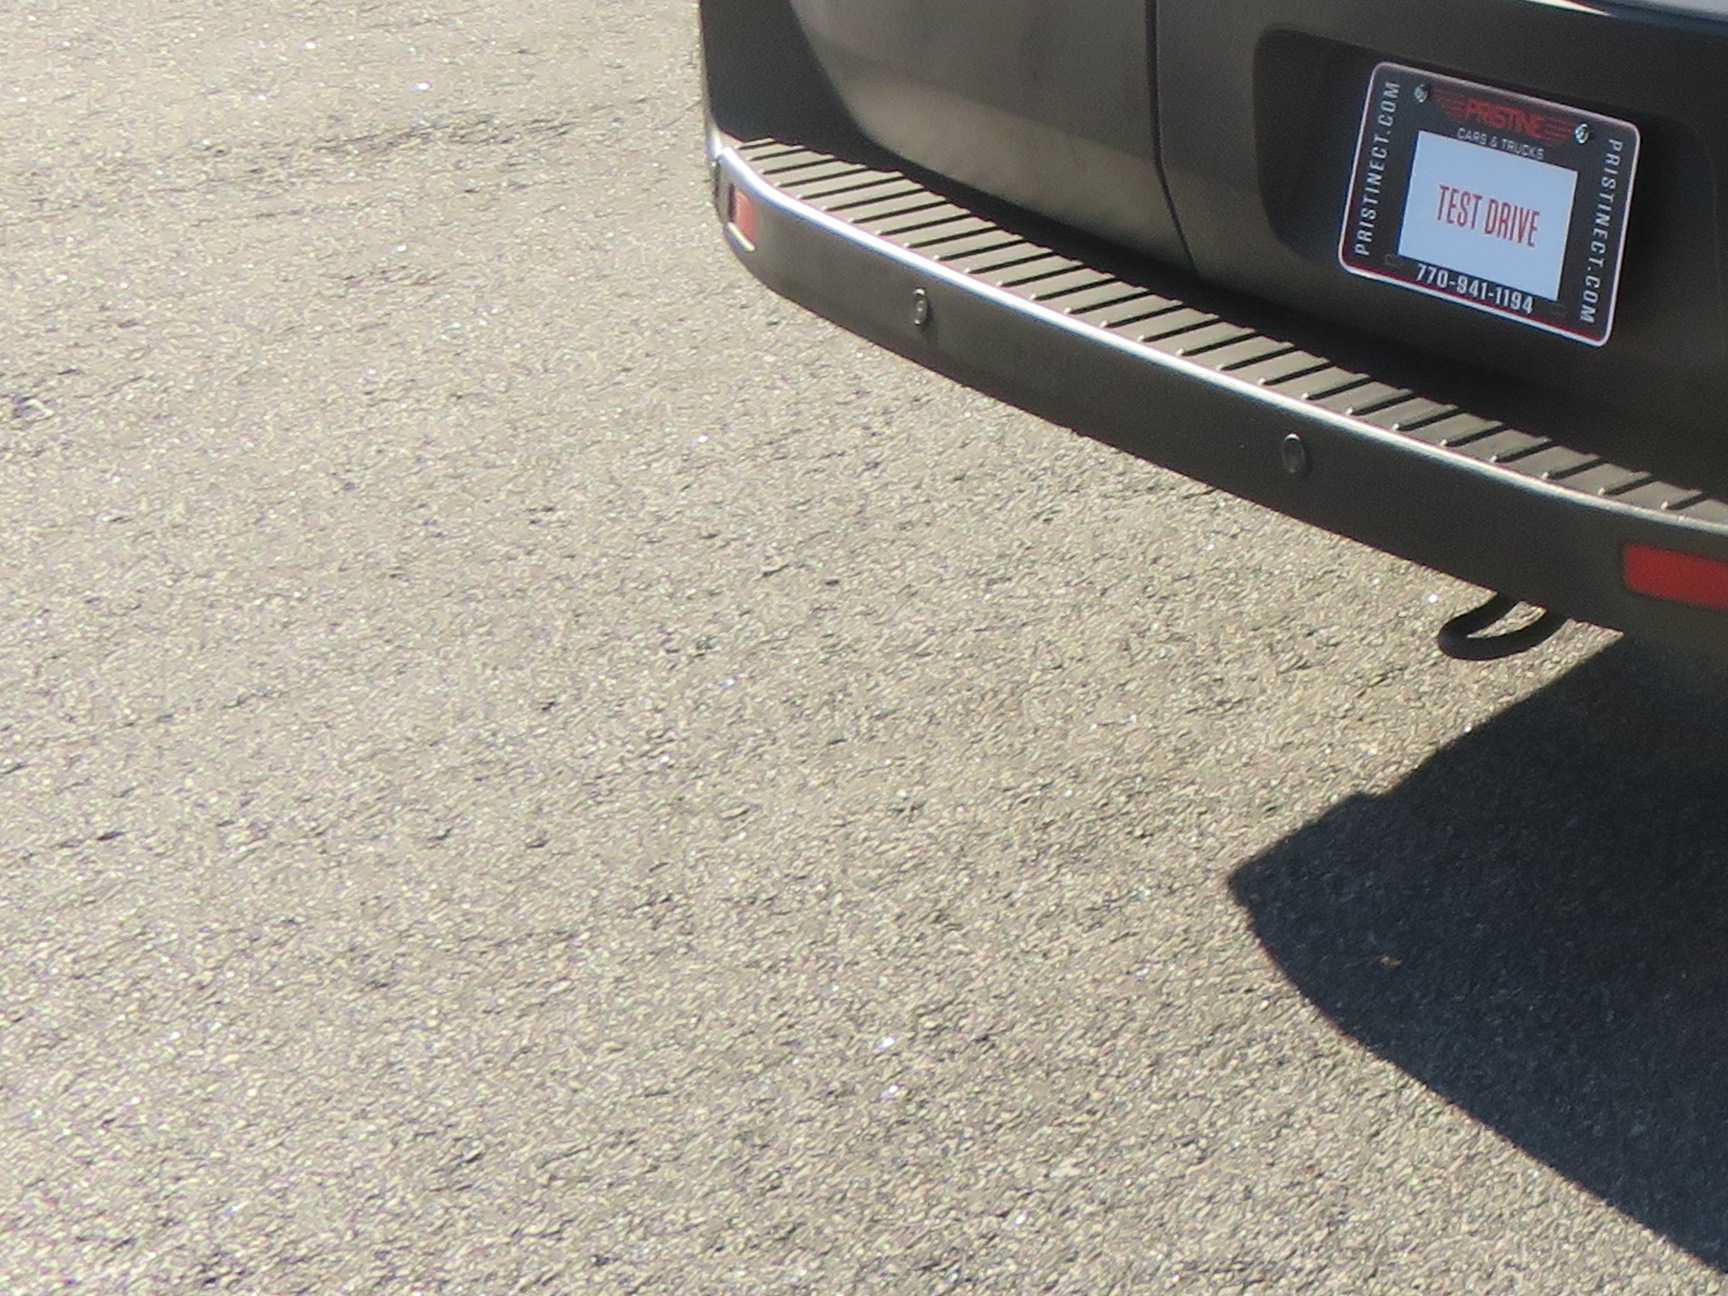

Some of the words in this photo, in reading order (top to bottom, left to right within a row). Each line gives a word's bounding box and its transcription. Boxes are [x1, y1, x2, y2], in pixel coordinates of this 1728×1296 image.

[1457, 127, 1487, 145] CARS
[1489, 136, 1498, 148] &
[1502, 138, 1544, 160] TRUCKS
[1464, 98, 1545, 138] PRISTINE
[1355, 82, 1400, 256] PRISTINECT.COM
[1437, 184, 1483, 228] TEST
[1484, 198, 1540, 248] DRIVE
[1580, 137, 1623, 324] PRISTINECT.COM
[1416, 264, 1535, 315] 770-941-1194
